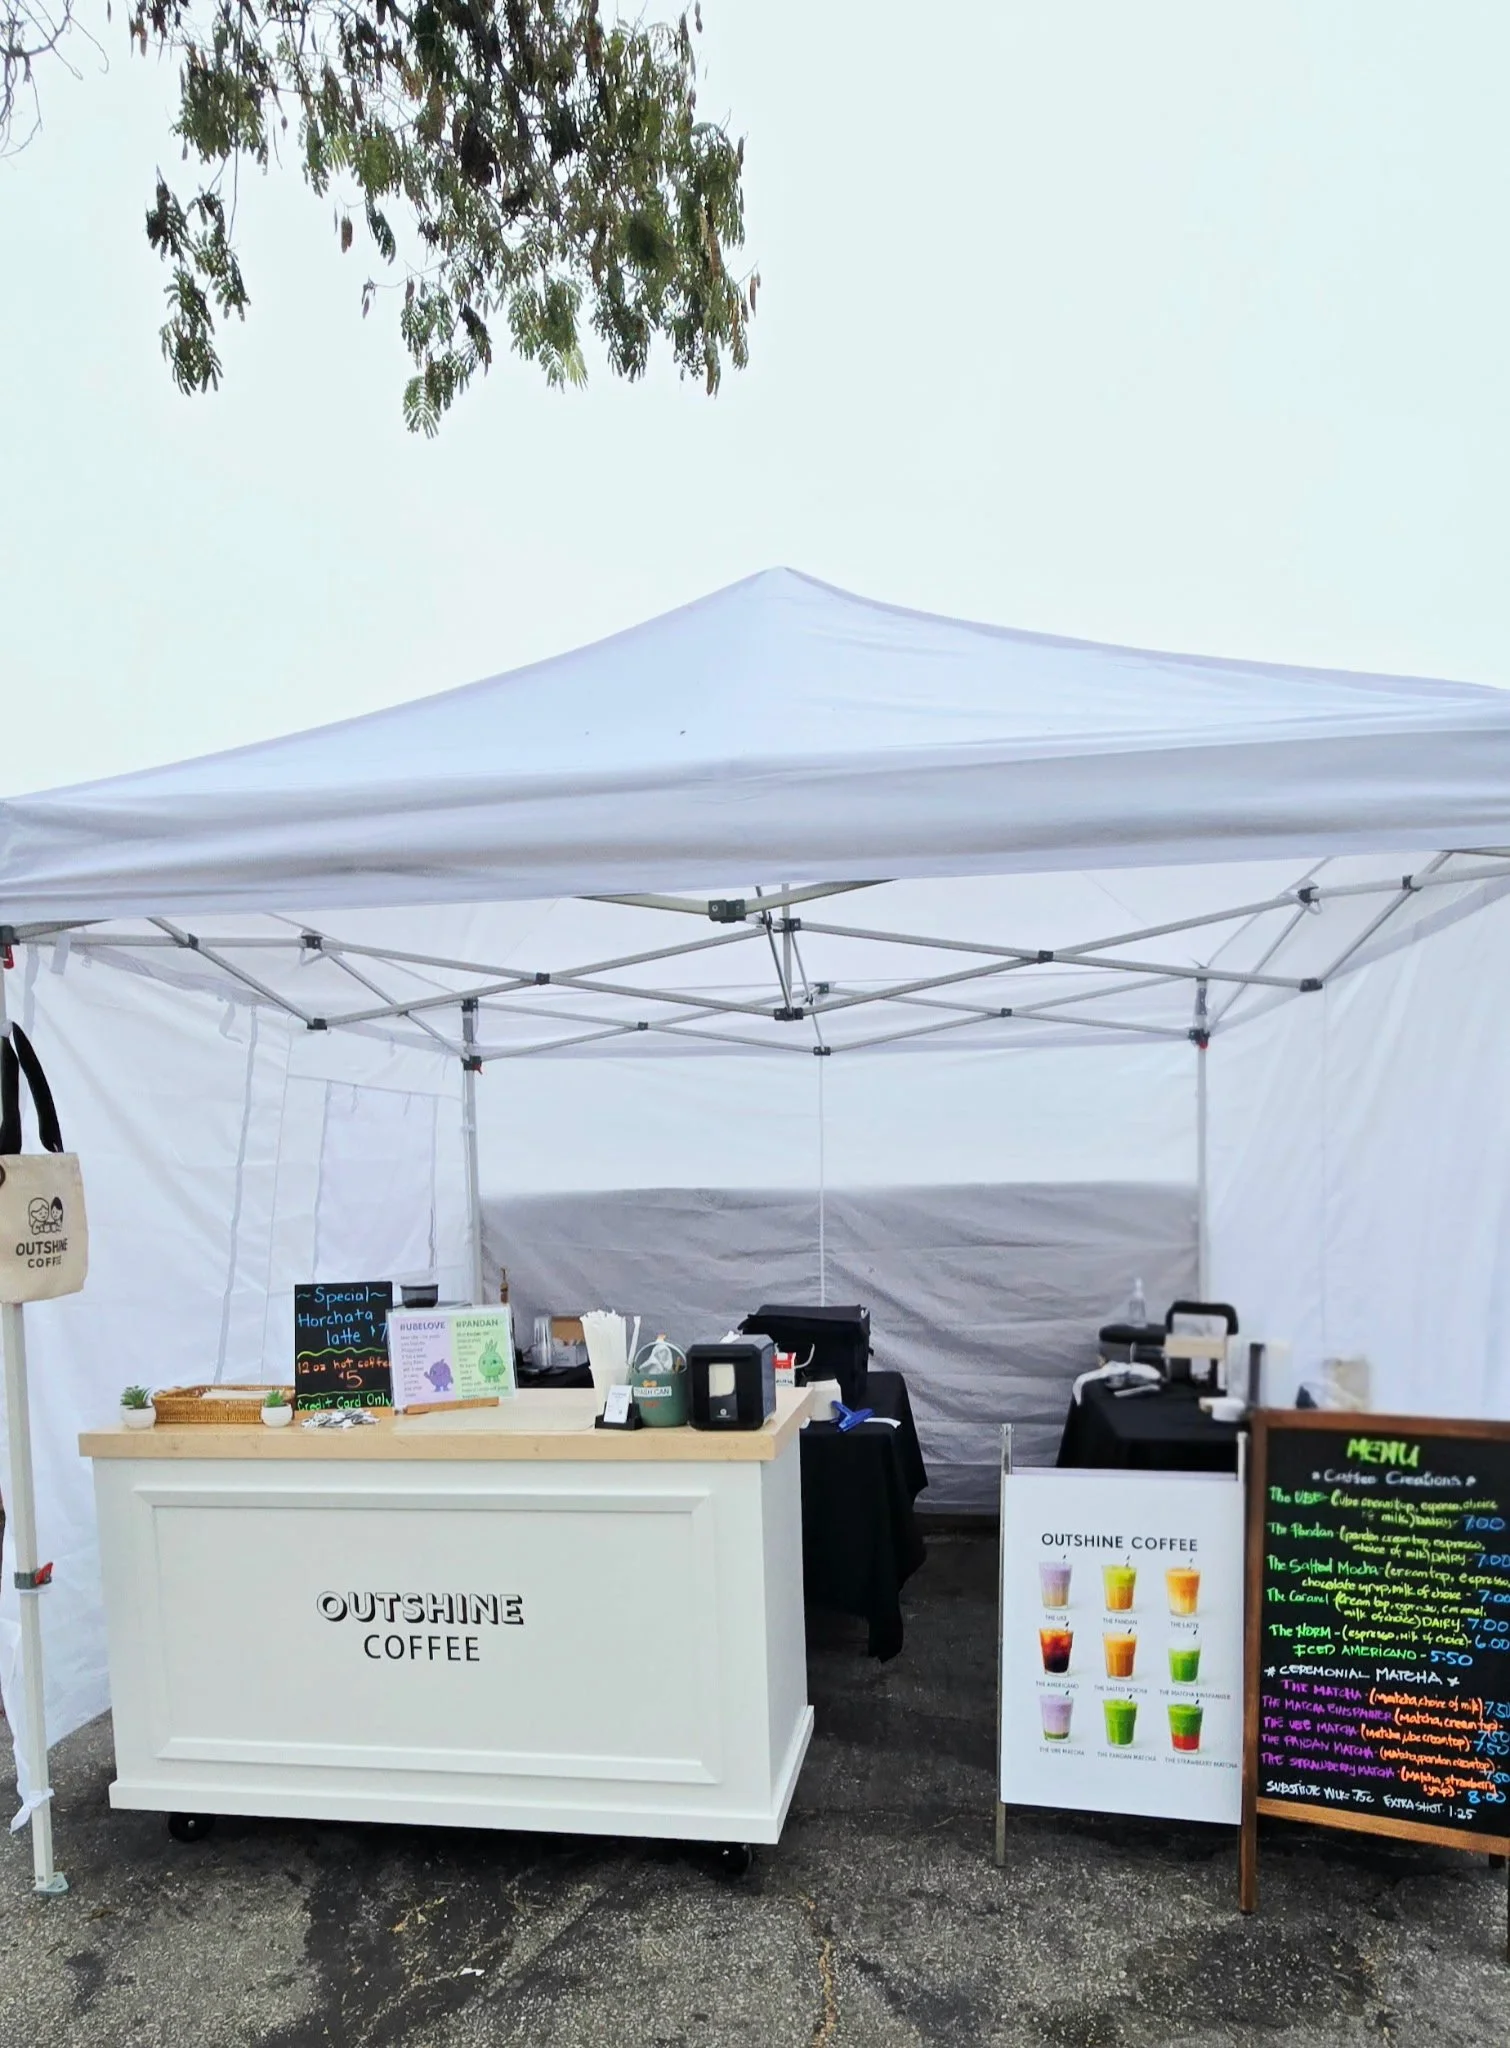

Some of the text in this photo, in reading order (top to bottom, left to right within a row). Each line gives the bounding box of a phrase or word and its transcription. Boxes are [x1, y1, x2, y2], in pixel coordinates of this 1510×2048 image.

[315, 1286, 368, 1311] Special
[298, 1308, 373, 1327] Horchata
[326, 1327, 361, 1346] latte
[298, 1361, 310, 1374] 12
[333, 1357, 353, 1369] hot
[337, 1393, 361, 1410] Card
[367, 1392, 393, 1406] Only
[1347, 1438, 1420, 1467] MENU
[1386, 1470, 1461, 1487] Creations
[1269, 1486, 1291, 1504] The
[1268, 1521, 1287, 1536] The
[1041, 1533, 1198, 1552] OUTSHINE COFFEE
[1353, 1542, 1386, 1555] choice
[1266, 1554, 1286, 1571] The
[1267, 1587, 1286, 1602] The
[1302, 1577, 1356, 1591] chocolate
[1417, 1584, 1430, 1599] of
[316, 1590, 524, 1625] OUTSHINE
[1344, 1608, 1367, 1621] milk
[1467, 1617, 1509, 1632] 7.00
[1268, 1624, 1293, 1637] The
[1295, 1622, 1331, 1640] NORM
[1475, 1634, 1510, 1650] 6.00
[364, 1634, 480, 1661] COFFEE
[1293, 1644, 1335, 1657] ICED
[1430, 1650, 1474, 1666] 5.50
[1279, 1664, 1443, 1685] CEREMONIAL MATCHA
[1281, 1679, 1309, 1693] THE
[1313, 1684, 1361, 1700] MATCHA
[1262, 1695, 1280, 1708] THE
[1264, 1716, 1284, 1729] THE
[1316, 1722, 1357, 1737] MATCHA
[1262, 1734, 1280, 1745] THE
[1334, 1741, 1374, 1758] MATCHA
[1261, 1752, 1284, 1765] THE
[1383, 1794, 1414, 1810] EXTRA
[1449, 1805, 1477, 1820] 1.25
